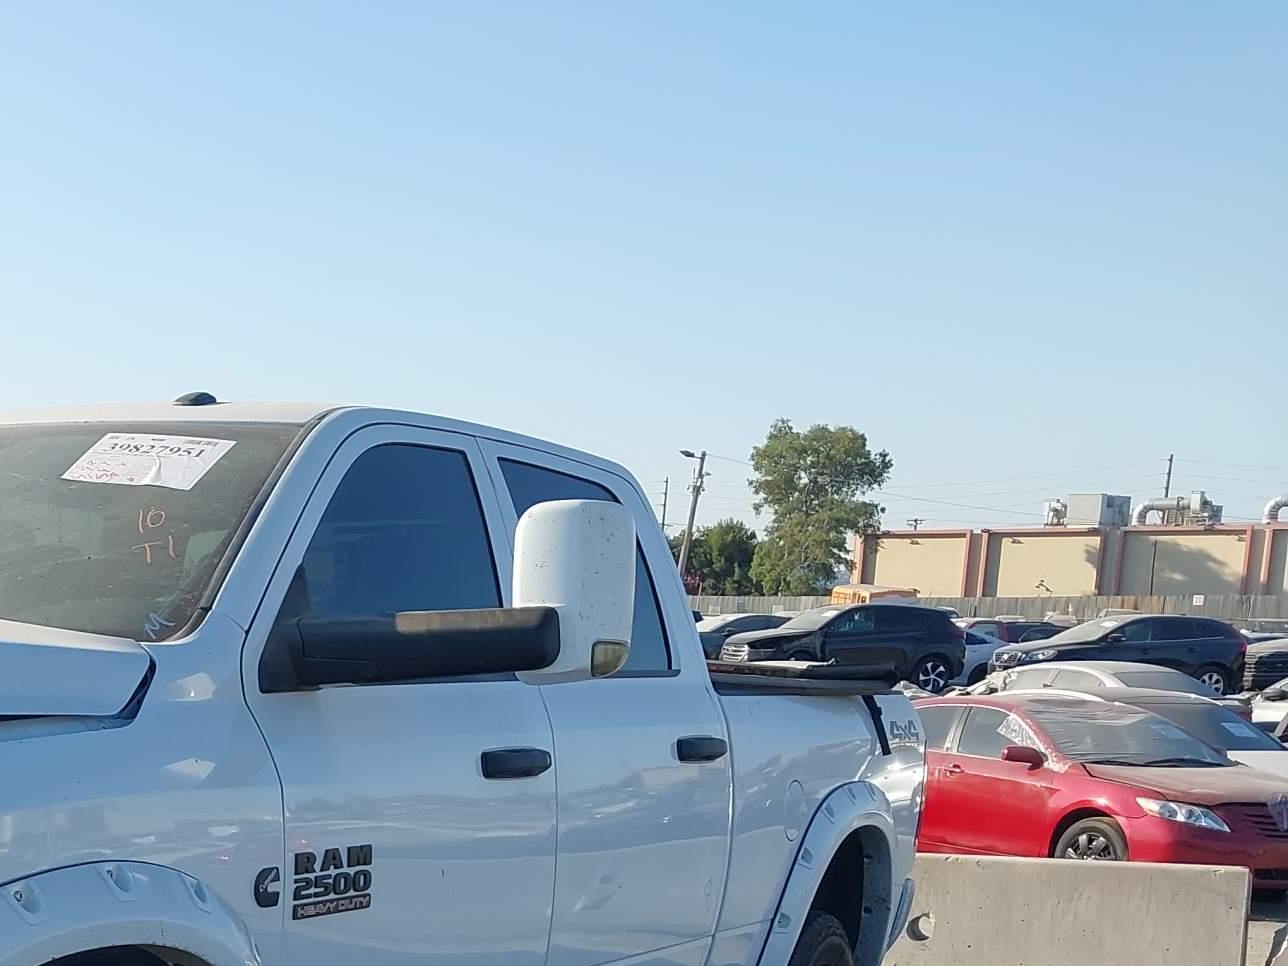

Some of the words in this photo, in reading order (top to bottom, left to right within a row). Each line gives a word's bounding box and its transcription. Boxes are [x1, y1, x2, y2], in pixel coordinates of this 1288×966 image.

[103, 442, 206, 458] 39827951
[294, 844, 373, 875] RAM
[293, 869, 372, 901] 2500
[297, 900, 338, 918] HEAVY
[337, 895, 369, 911] DUTY
